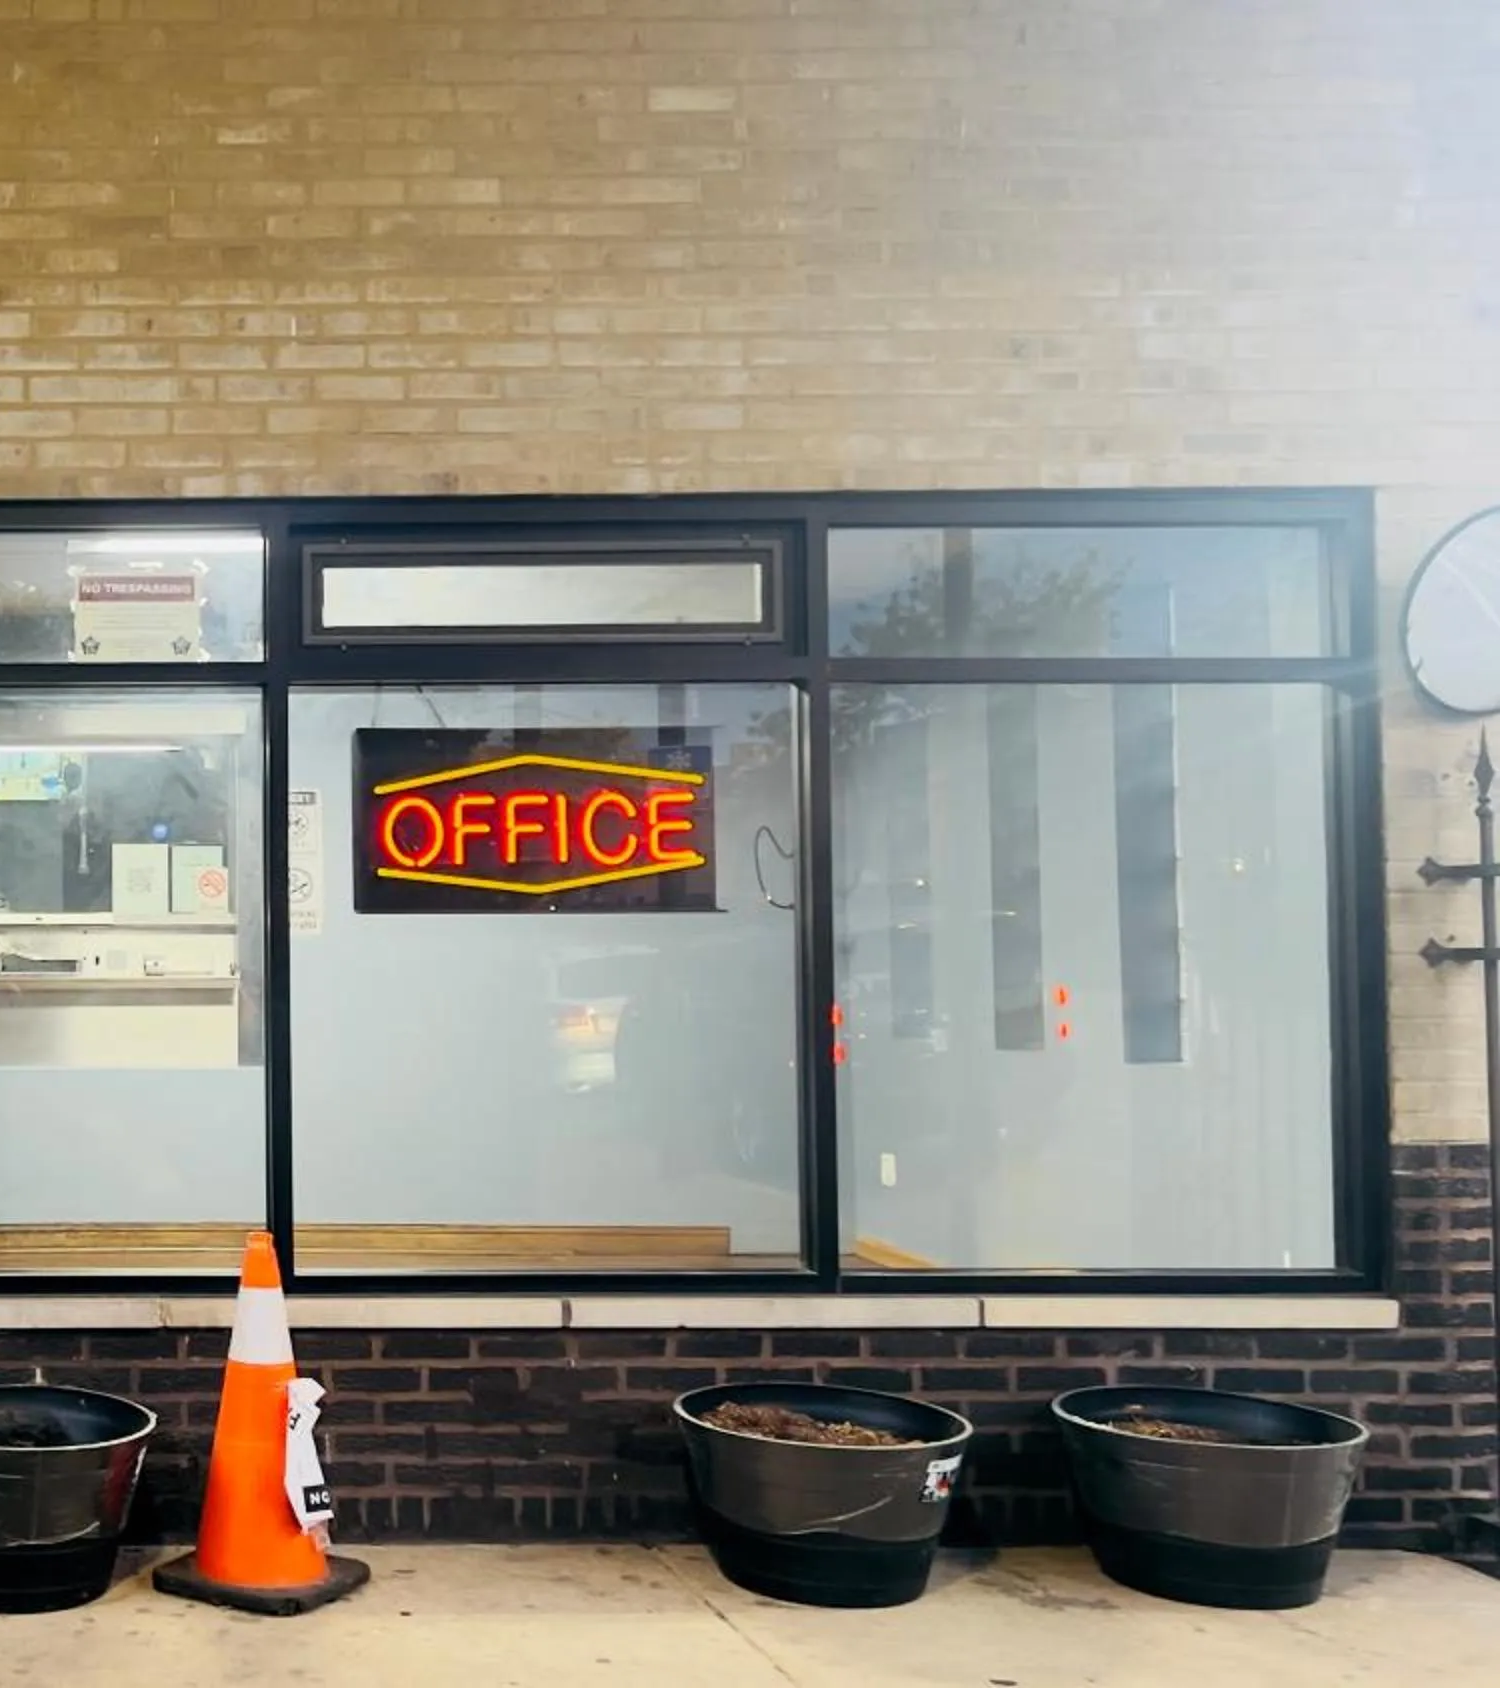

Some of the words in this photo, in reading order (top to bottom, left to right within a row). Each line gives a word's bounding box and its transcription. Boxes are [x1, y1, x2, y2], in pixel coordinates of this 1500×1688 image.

[81, 582, 101, 594] NO
[104, 582, 193, 595] TRESPASSING
[383, 790, 697, 867] OFFICE
